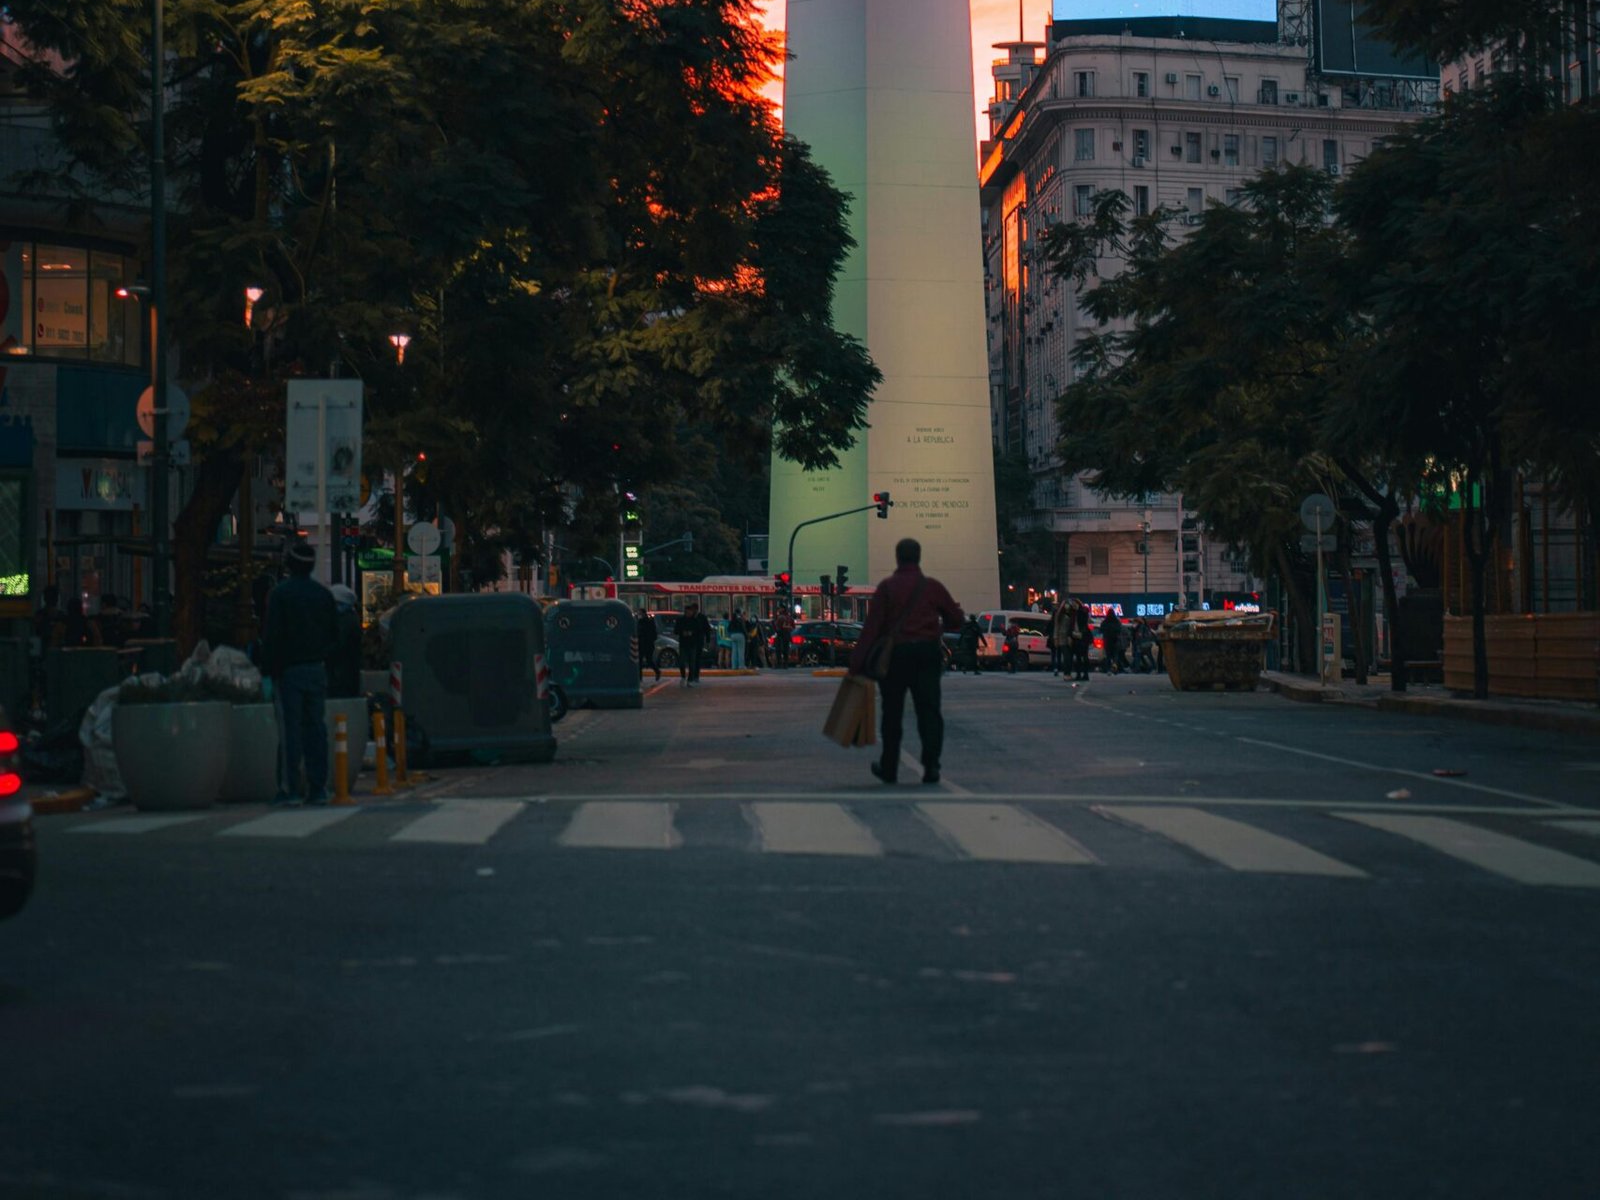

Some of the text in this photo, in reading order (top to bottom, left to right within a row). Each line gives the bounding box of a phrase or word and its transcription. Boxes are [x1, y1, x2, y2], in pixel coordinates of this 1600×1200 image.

[913, 435, 921, 443] LA
[910, 500, 930, 508] PEDRO
[931, 500, 939, 508] DE
[942, 500, 969, 508] MENDOZA
[678, 584, 740, 592] TRANSPORTES
